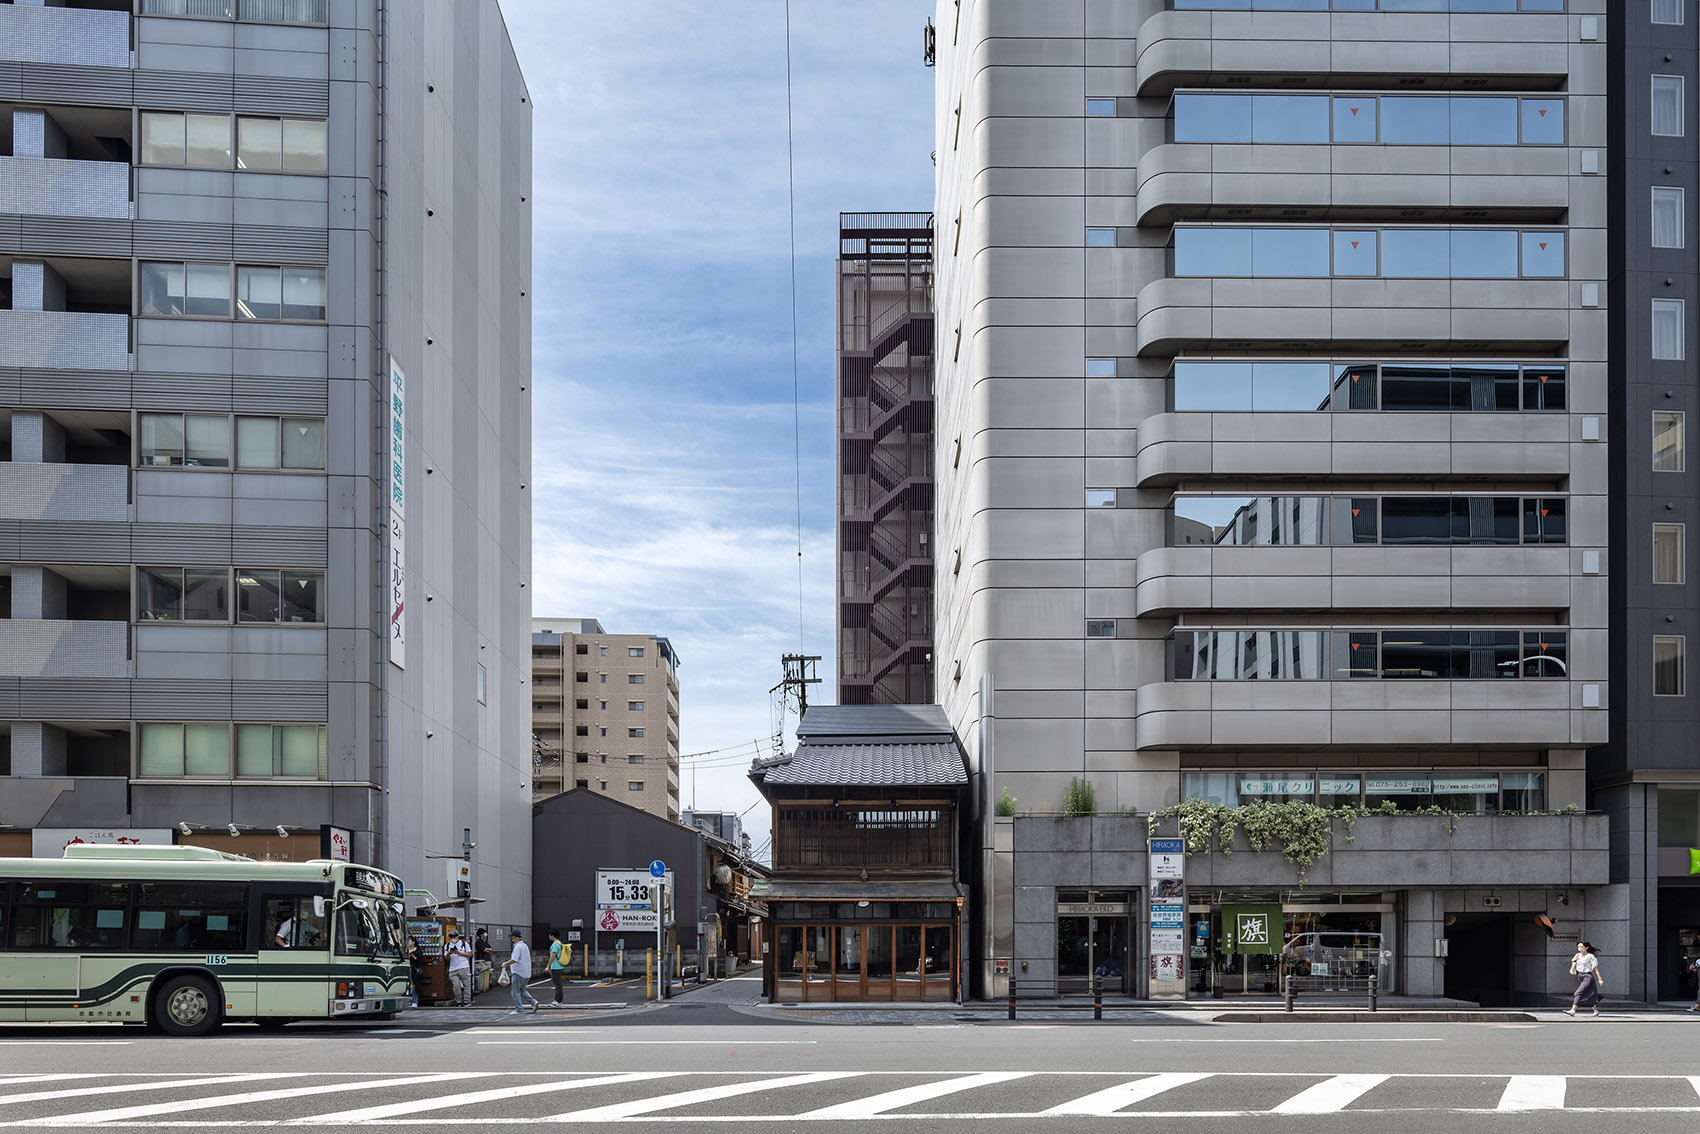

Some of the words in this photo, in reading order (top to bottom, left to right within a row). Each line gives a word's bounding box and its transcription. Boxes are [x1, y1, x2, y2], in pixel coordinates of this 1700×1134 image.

[392, 519, 403, 540] 2F
[1241, 917, 1266, 942] 旗
[207, 955, 226, 964] 1156
[1160, 956, 1174, 968] 旗
